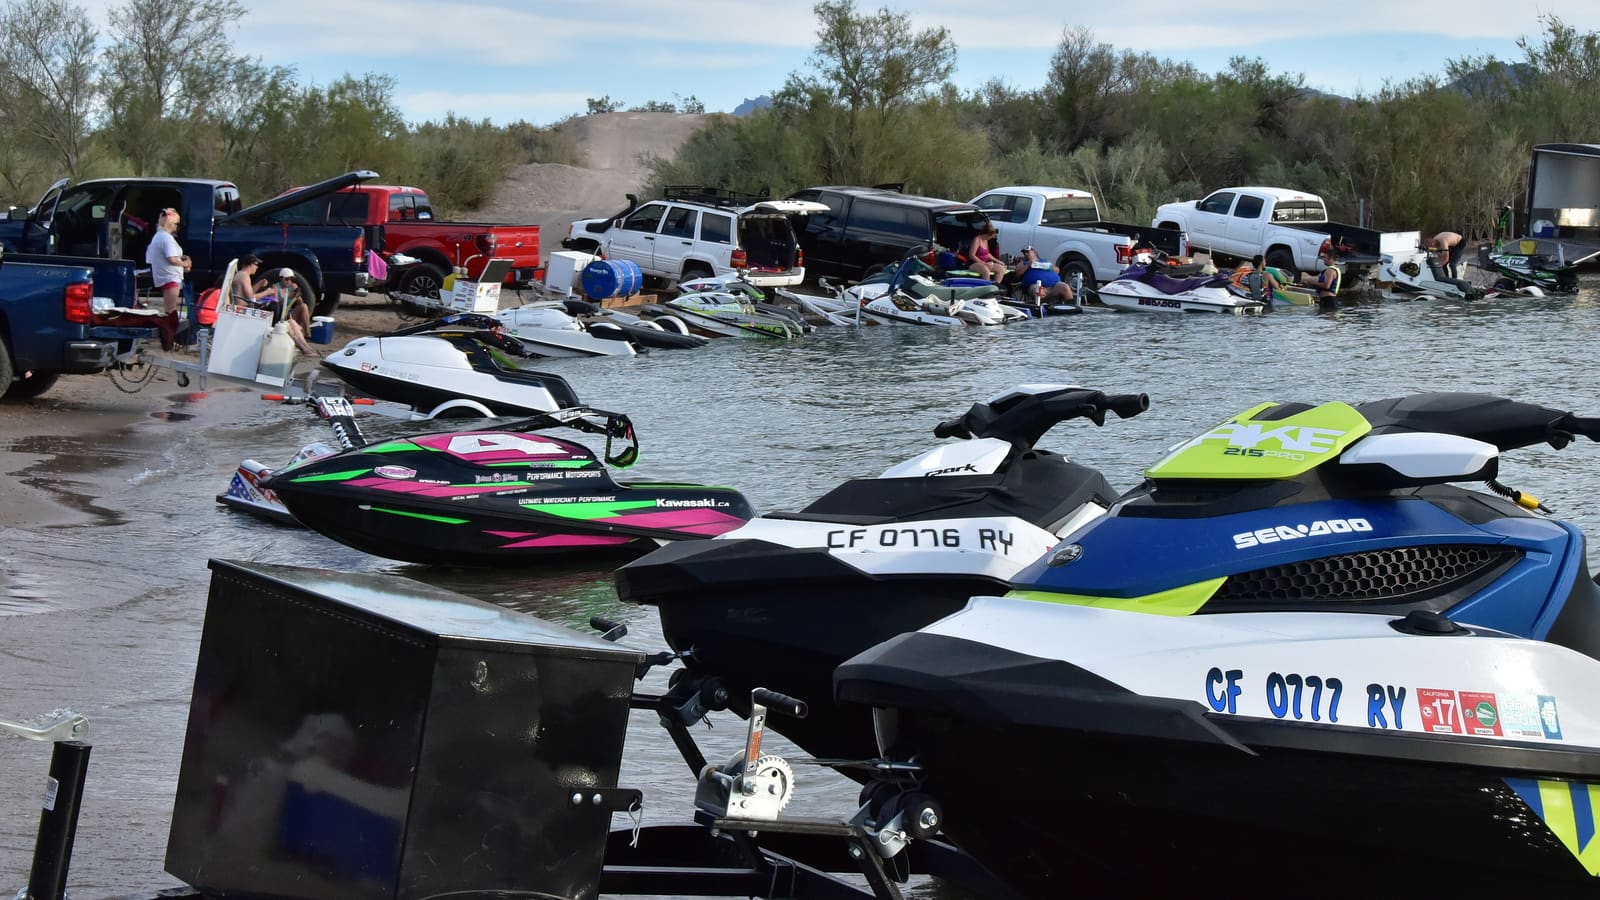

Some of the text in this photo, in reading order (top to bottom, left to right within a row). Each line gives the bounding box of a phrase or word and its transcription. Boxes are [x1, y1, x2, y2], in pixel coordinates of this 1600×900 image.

[1176, 423, 1345, 454] AKE
[527, 472, 564, 480] PERFORMANCE
[565, 470, 601, 478] MOTORSPORTS
[578, 495, 616, 503] PERFORMANCE
[827, 528, 1014, 555] CF 0776 RY
[1206, 667, 1406, 729] CF 0777 RY
[1432, 698, 1454, 725] 17
